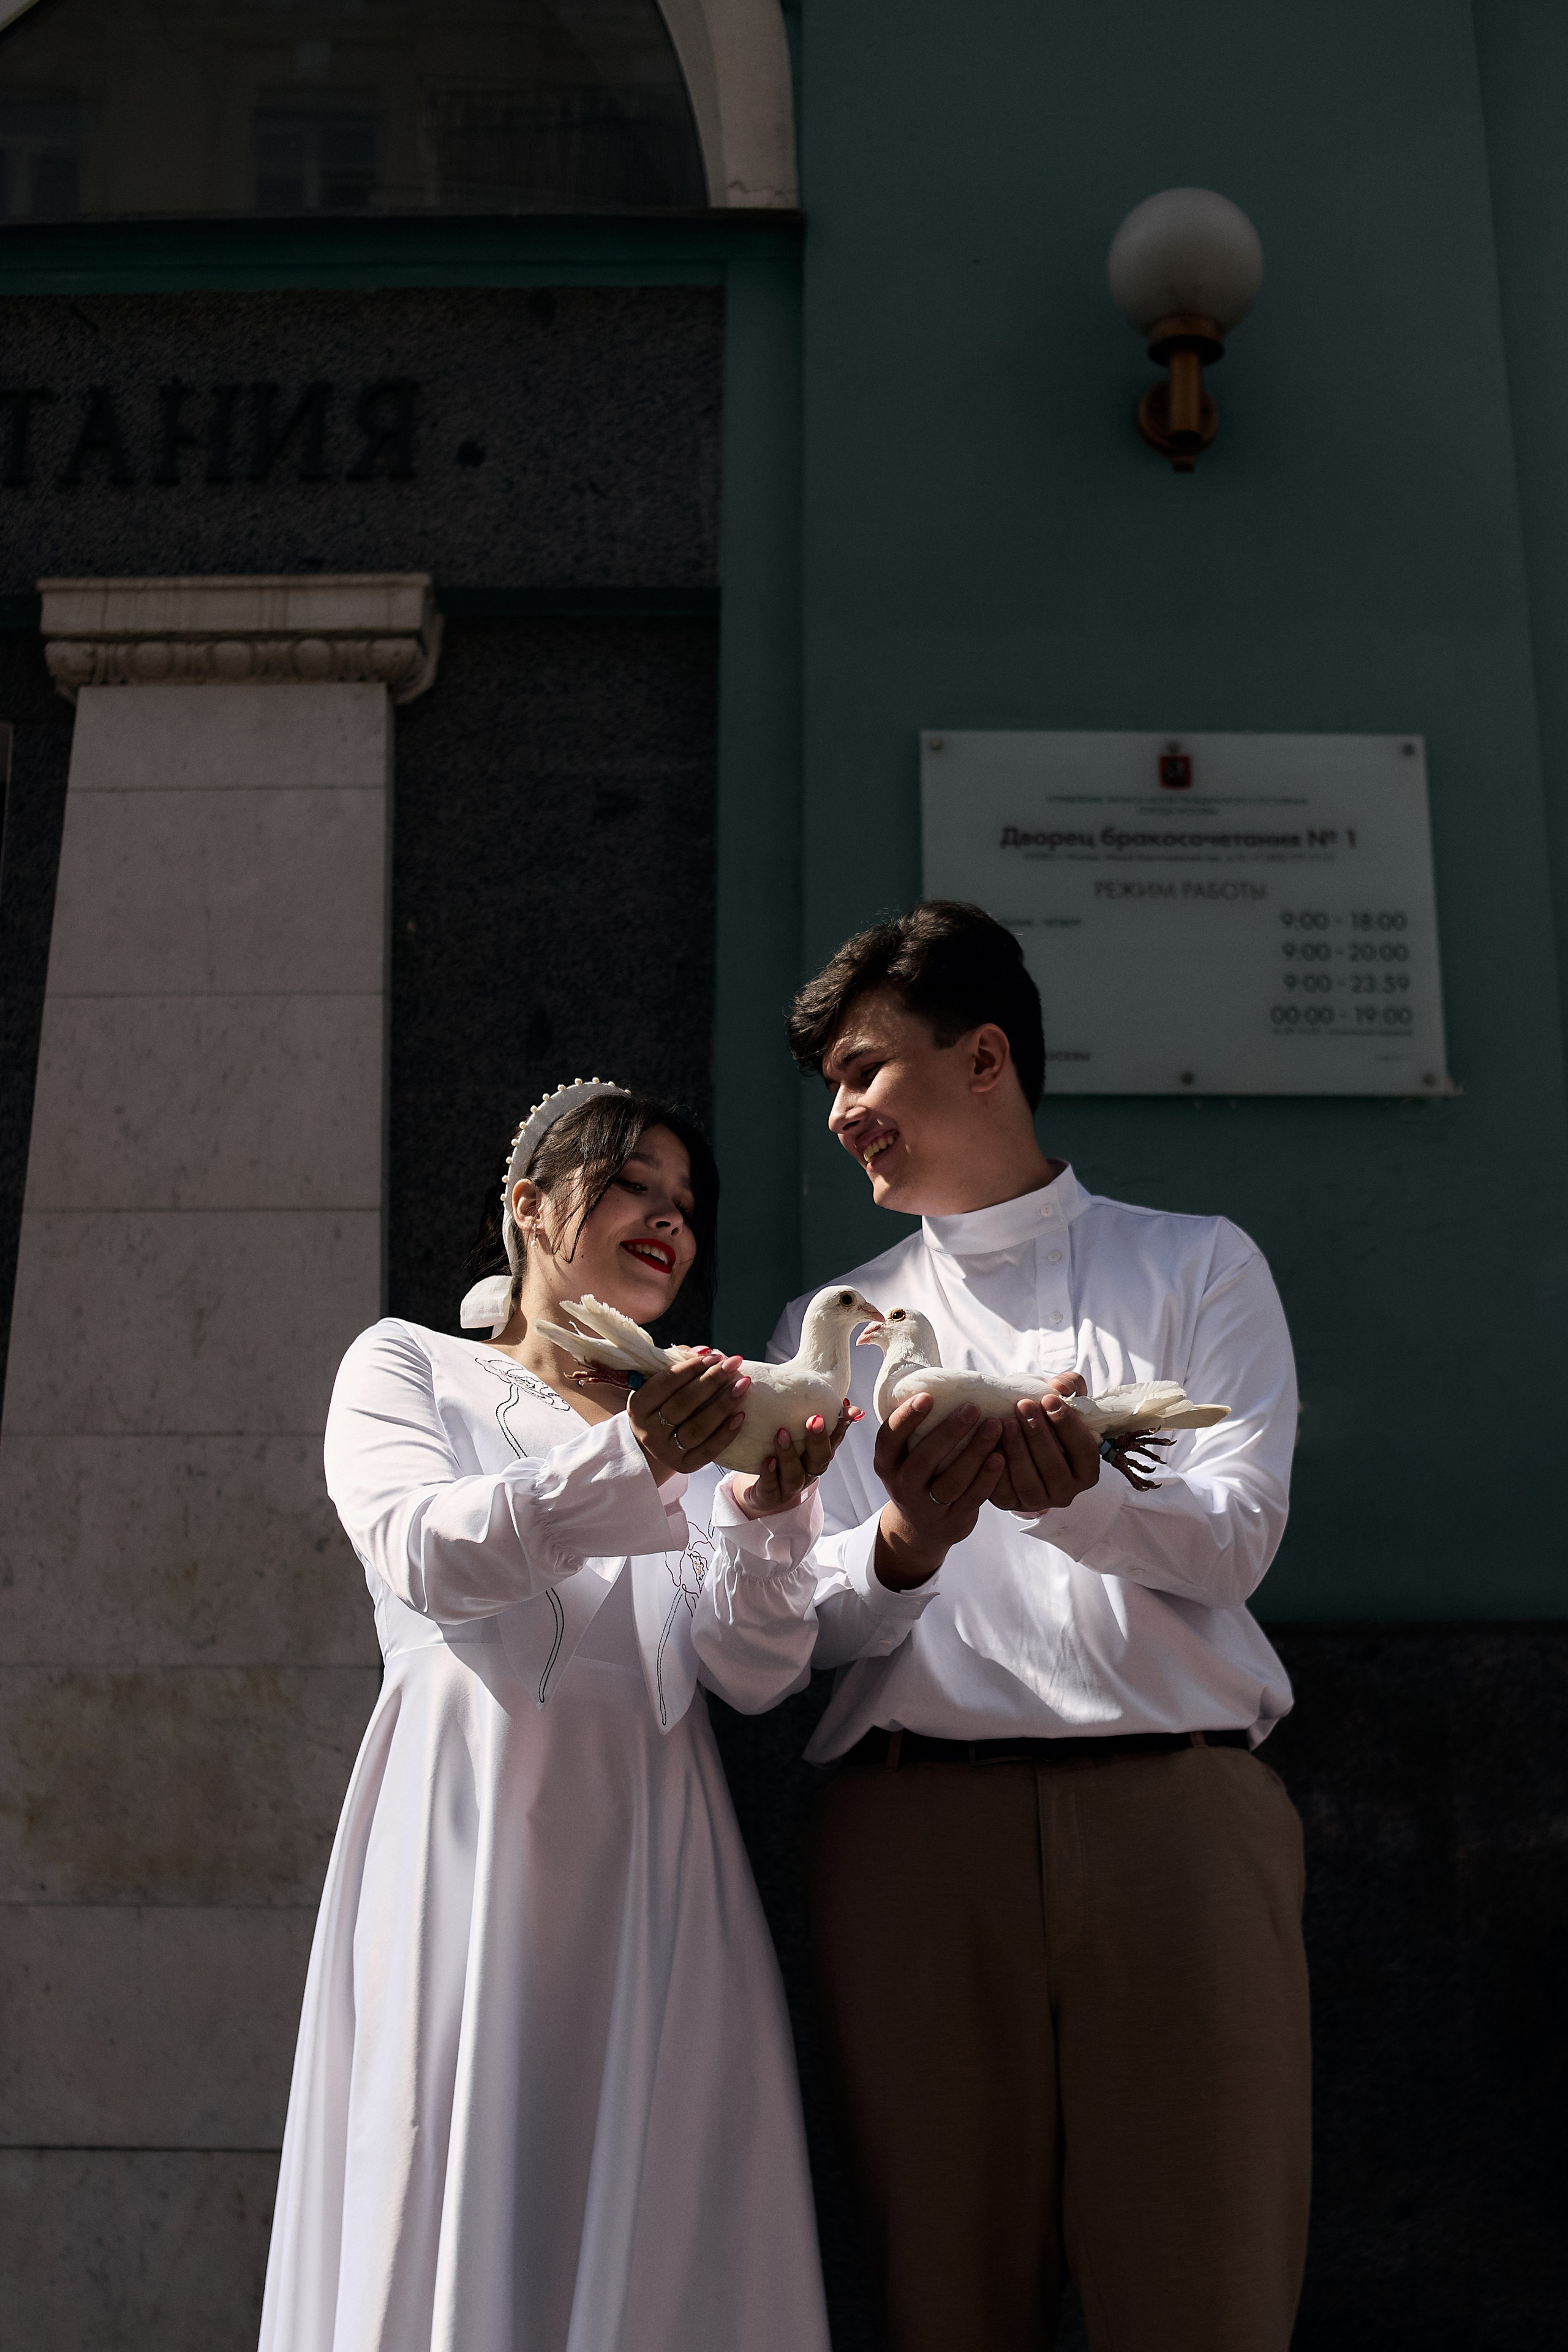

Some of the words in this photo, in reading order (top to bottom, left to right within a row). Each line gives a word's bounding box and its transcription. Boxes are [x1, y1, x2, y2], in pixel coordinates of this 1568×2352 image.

[1001, 827, 1096, 851] Дворец
[1101, 825, 1301, 851] бракосочетания
[1346, 828, 1357, 849] 1
[1094, 880, 1175, 899] РЕЖИМ
[1182, 881, 1267, 900] РАБОТЫ
